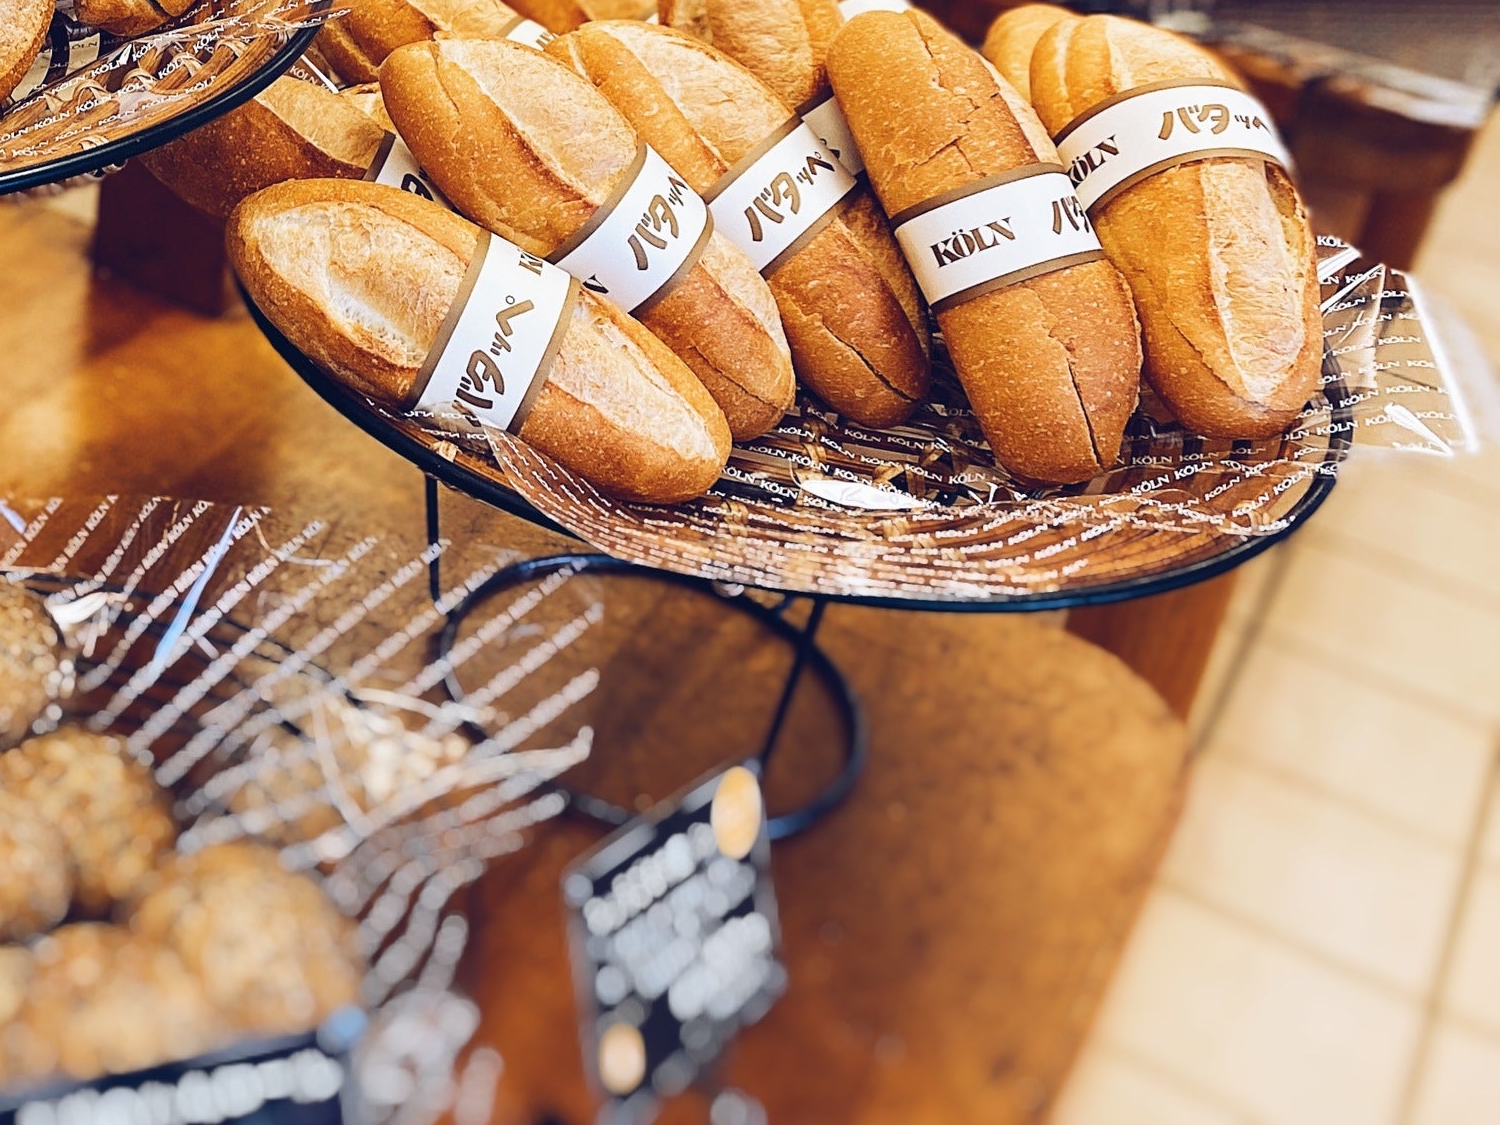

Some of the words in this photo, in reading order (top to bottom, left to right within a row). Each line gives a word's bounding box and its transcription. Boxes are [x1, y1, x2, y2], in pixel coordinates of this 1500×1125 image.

[290, 65, 316, 83] KÖLN
[744, 151, 835, 241] バタッペ
[930, 217, 1015, 268] KÖLN
[451, 295, 534, 428] バタッペ
[759, 479, 799, 498] KÖLN
[1131, 475, 1169, 495] KÖLN
[1174, 461, 1214, 480] KÖLN
